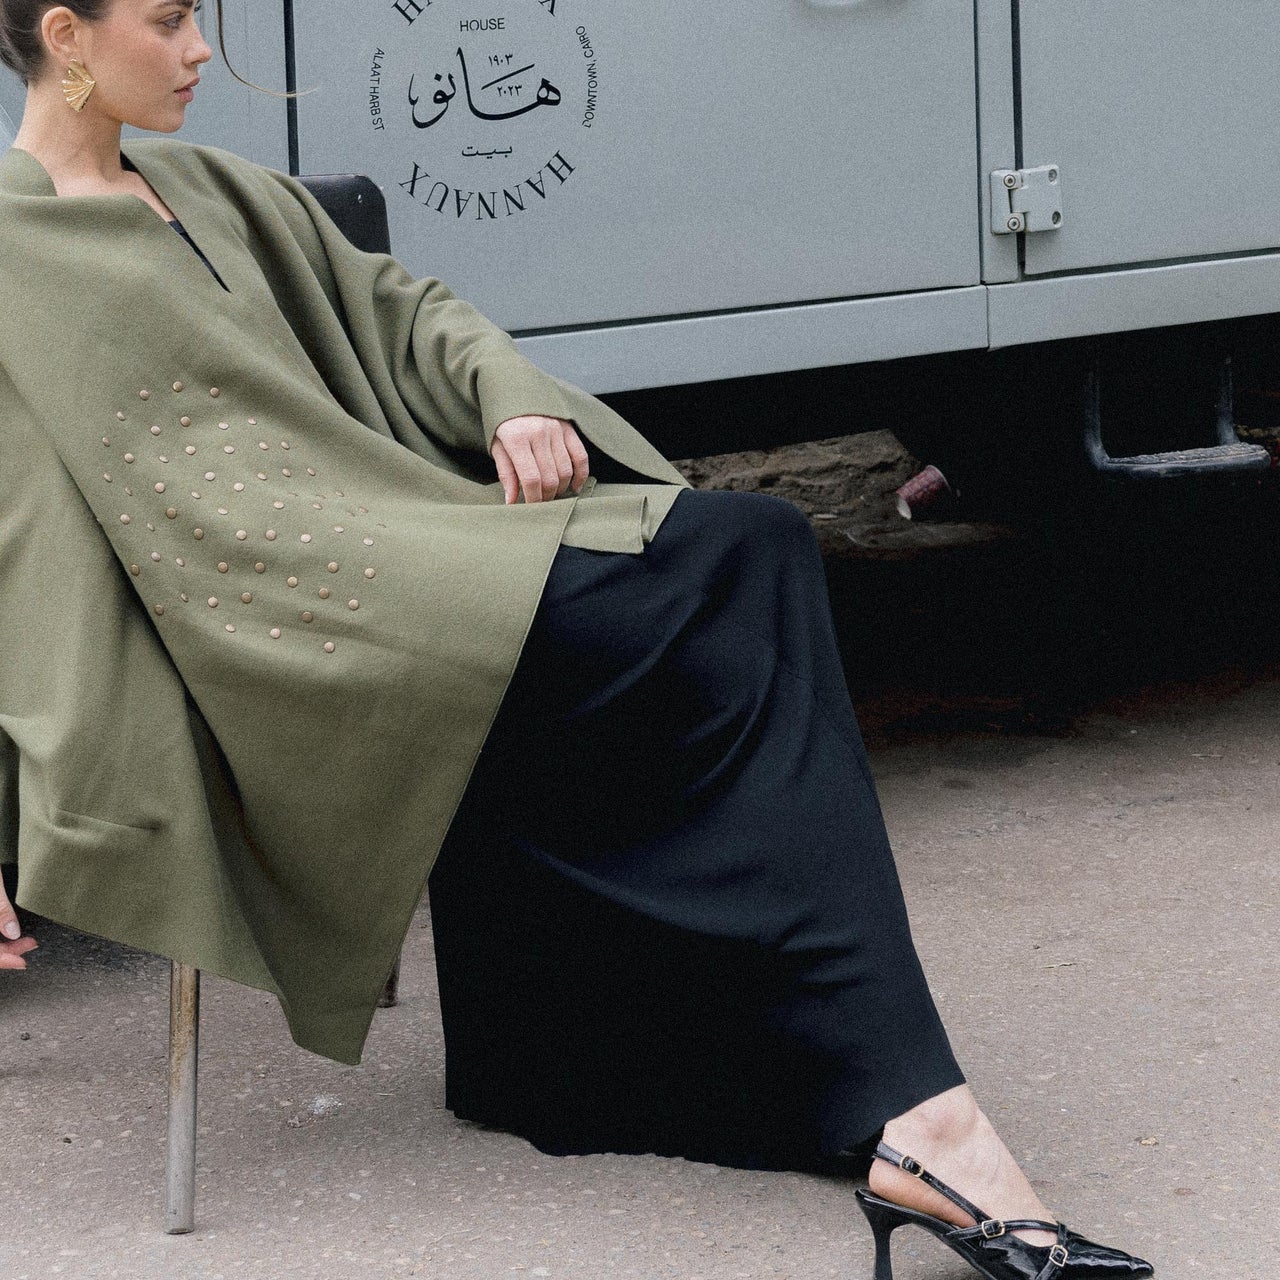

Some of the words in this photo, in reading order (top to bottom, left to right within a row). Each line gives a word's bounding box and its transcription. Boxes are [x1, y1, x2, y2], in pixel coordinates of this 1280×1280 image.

[460, 18, 505, 31] HOUSE
[575, 26, 594, 58] CAIRO
[369, 86, 381, 116] HARB
[372, 117, 385, 131] ST
[461, 145, 513, 159] بيت
[398, 150, 577, 221] HANNAUX
